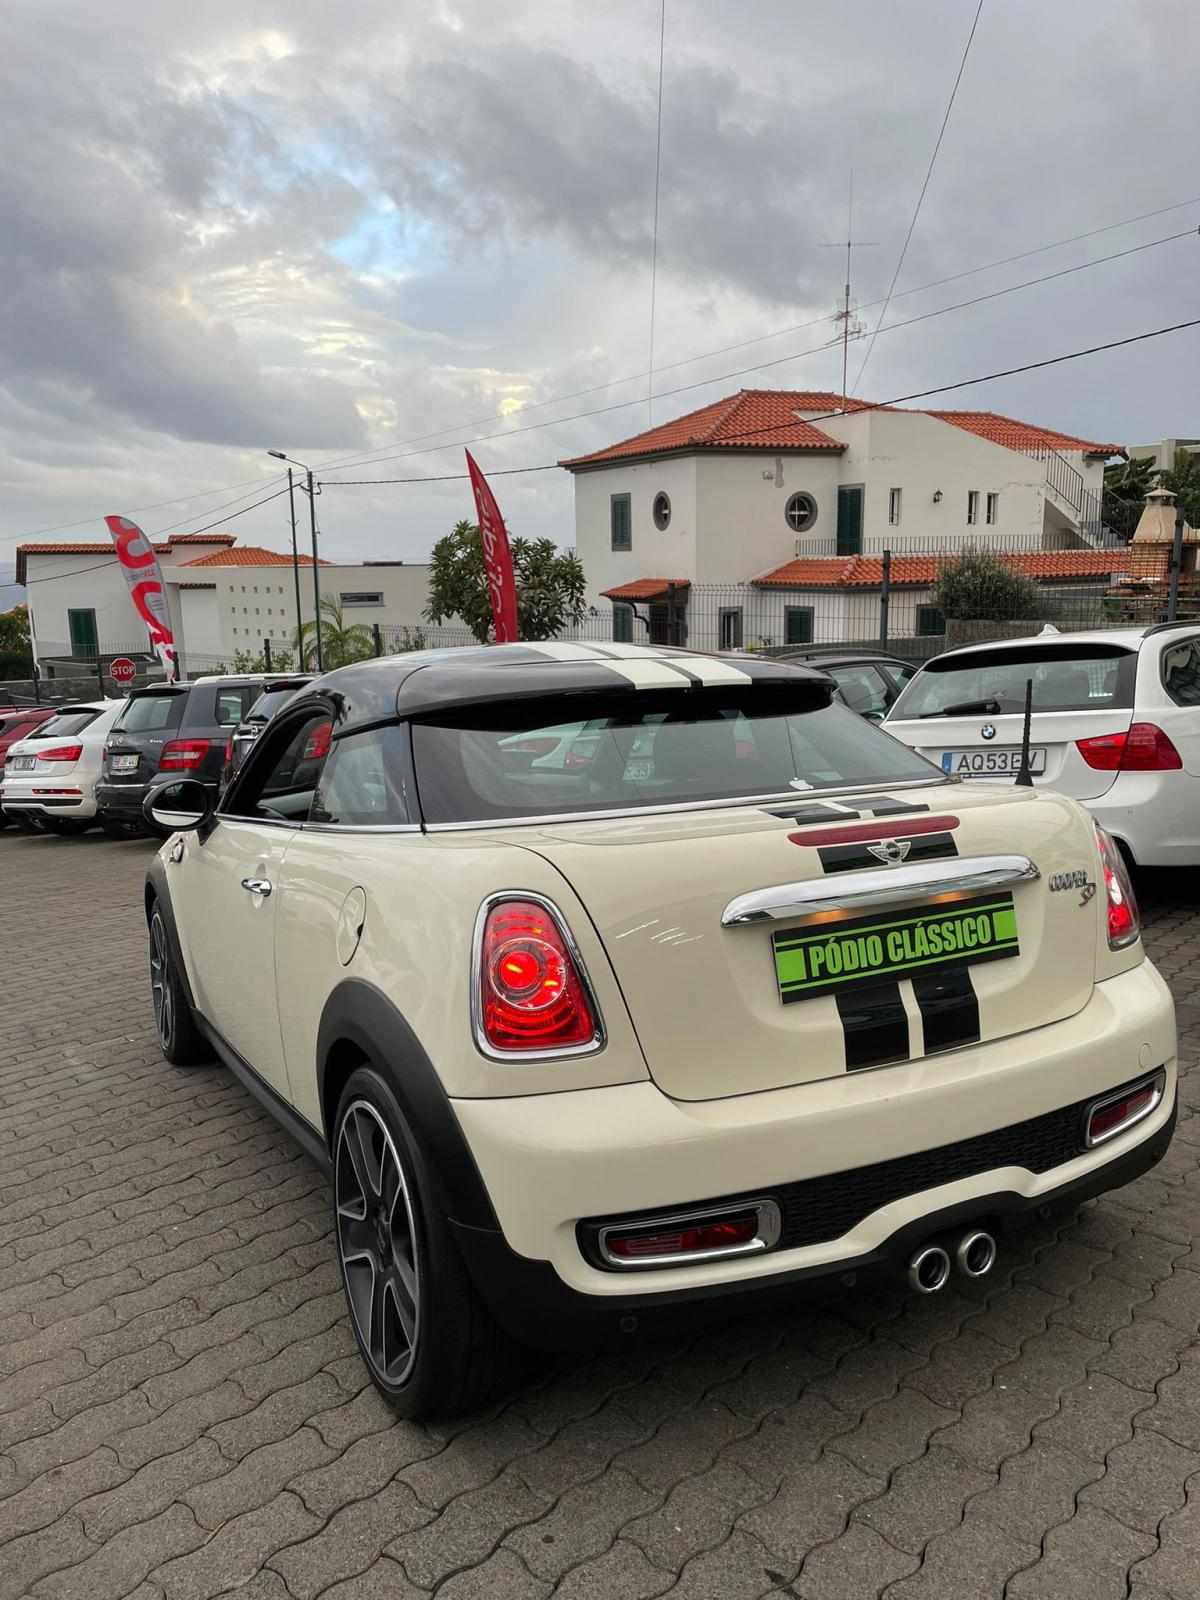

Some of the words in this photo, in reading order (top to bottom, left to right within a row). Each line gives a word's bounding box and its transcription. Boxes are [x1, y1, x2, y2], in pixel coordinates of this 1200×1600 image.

[111, 665, 135, 676] STOP
[808, 935, 884, 977] PÓDIO
[886, 914, 992, 962] CLÁSSICO
